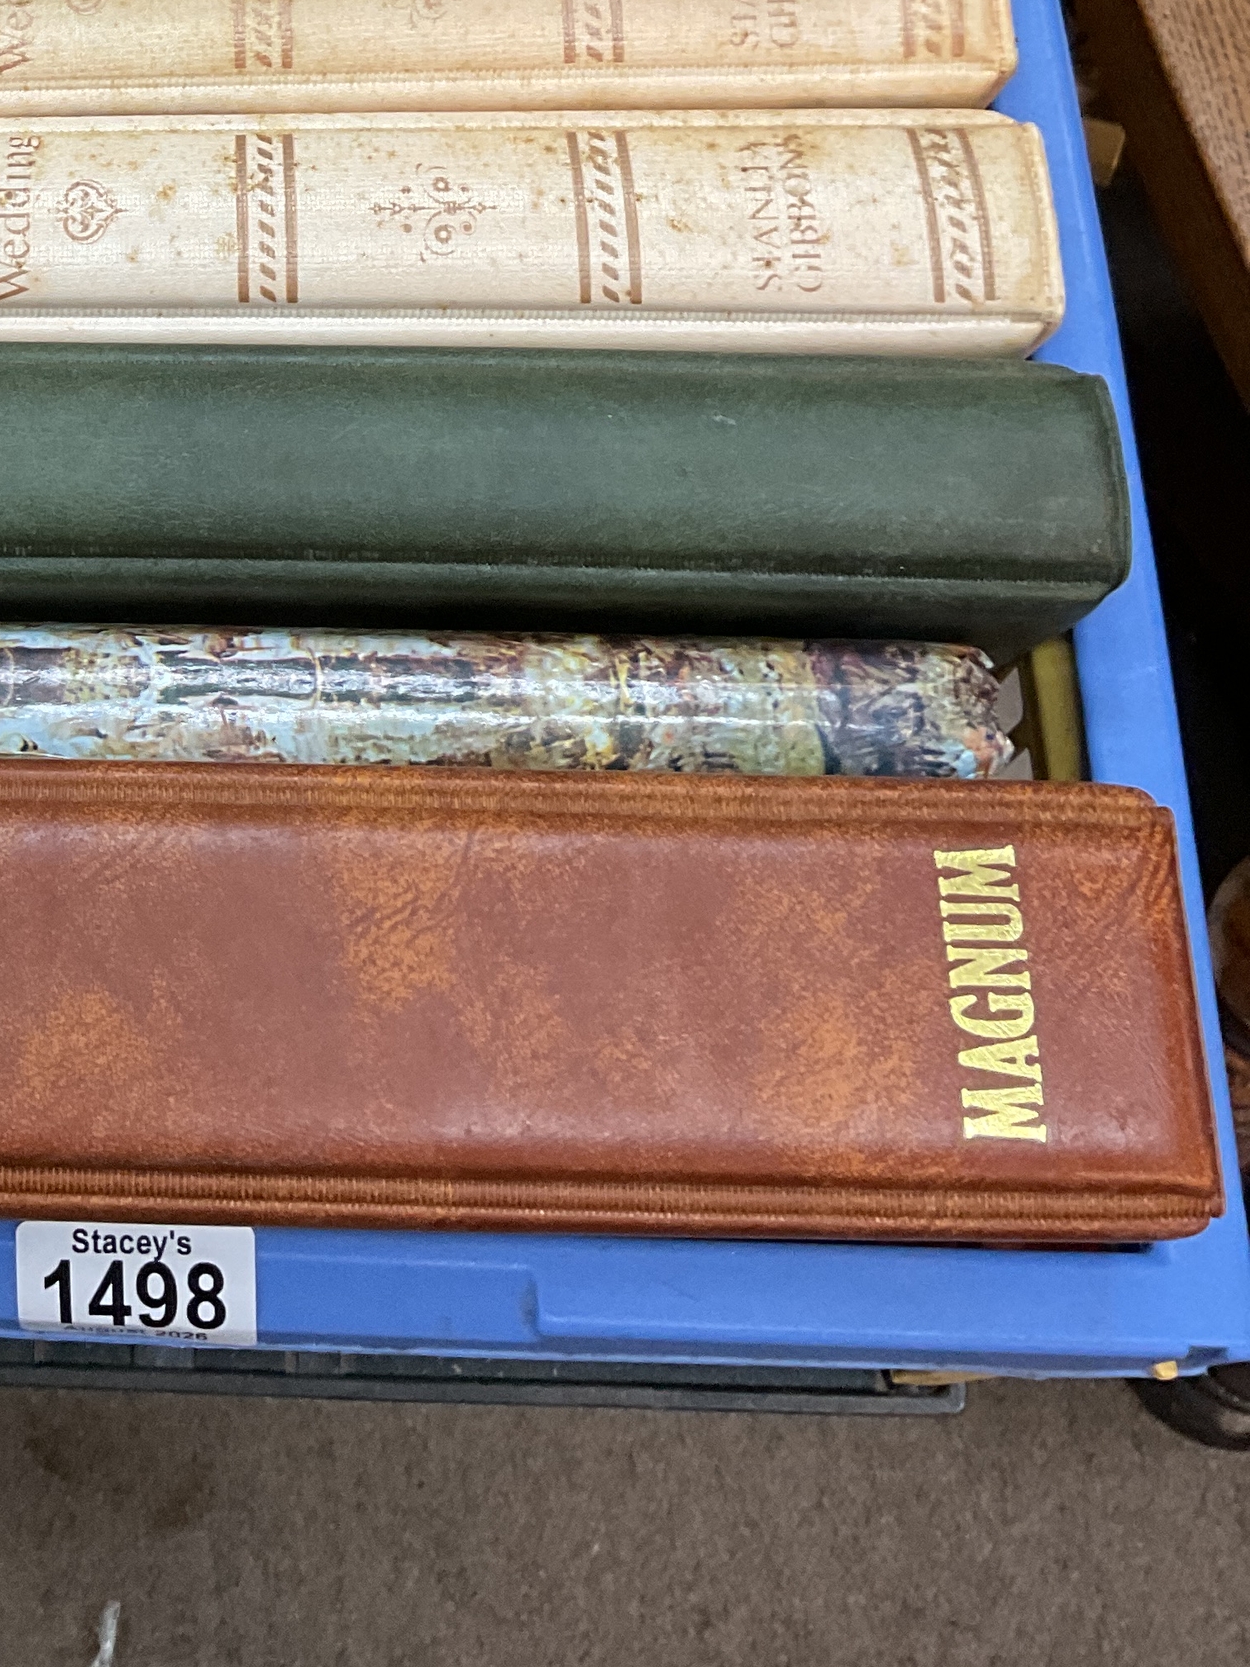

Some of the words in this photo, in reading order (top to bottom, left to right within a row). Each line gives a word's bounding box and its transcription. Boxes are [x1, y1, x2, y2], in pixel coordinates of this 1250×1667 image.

[933, 844, 1047, 1143] MAGNUM
[71, 1228, 192, 1262] Stacey's
[44, 1258, 226, 1330] 1498
